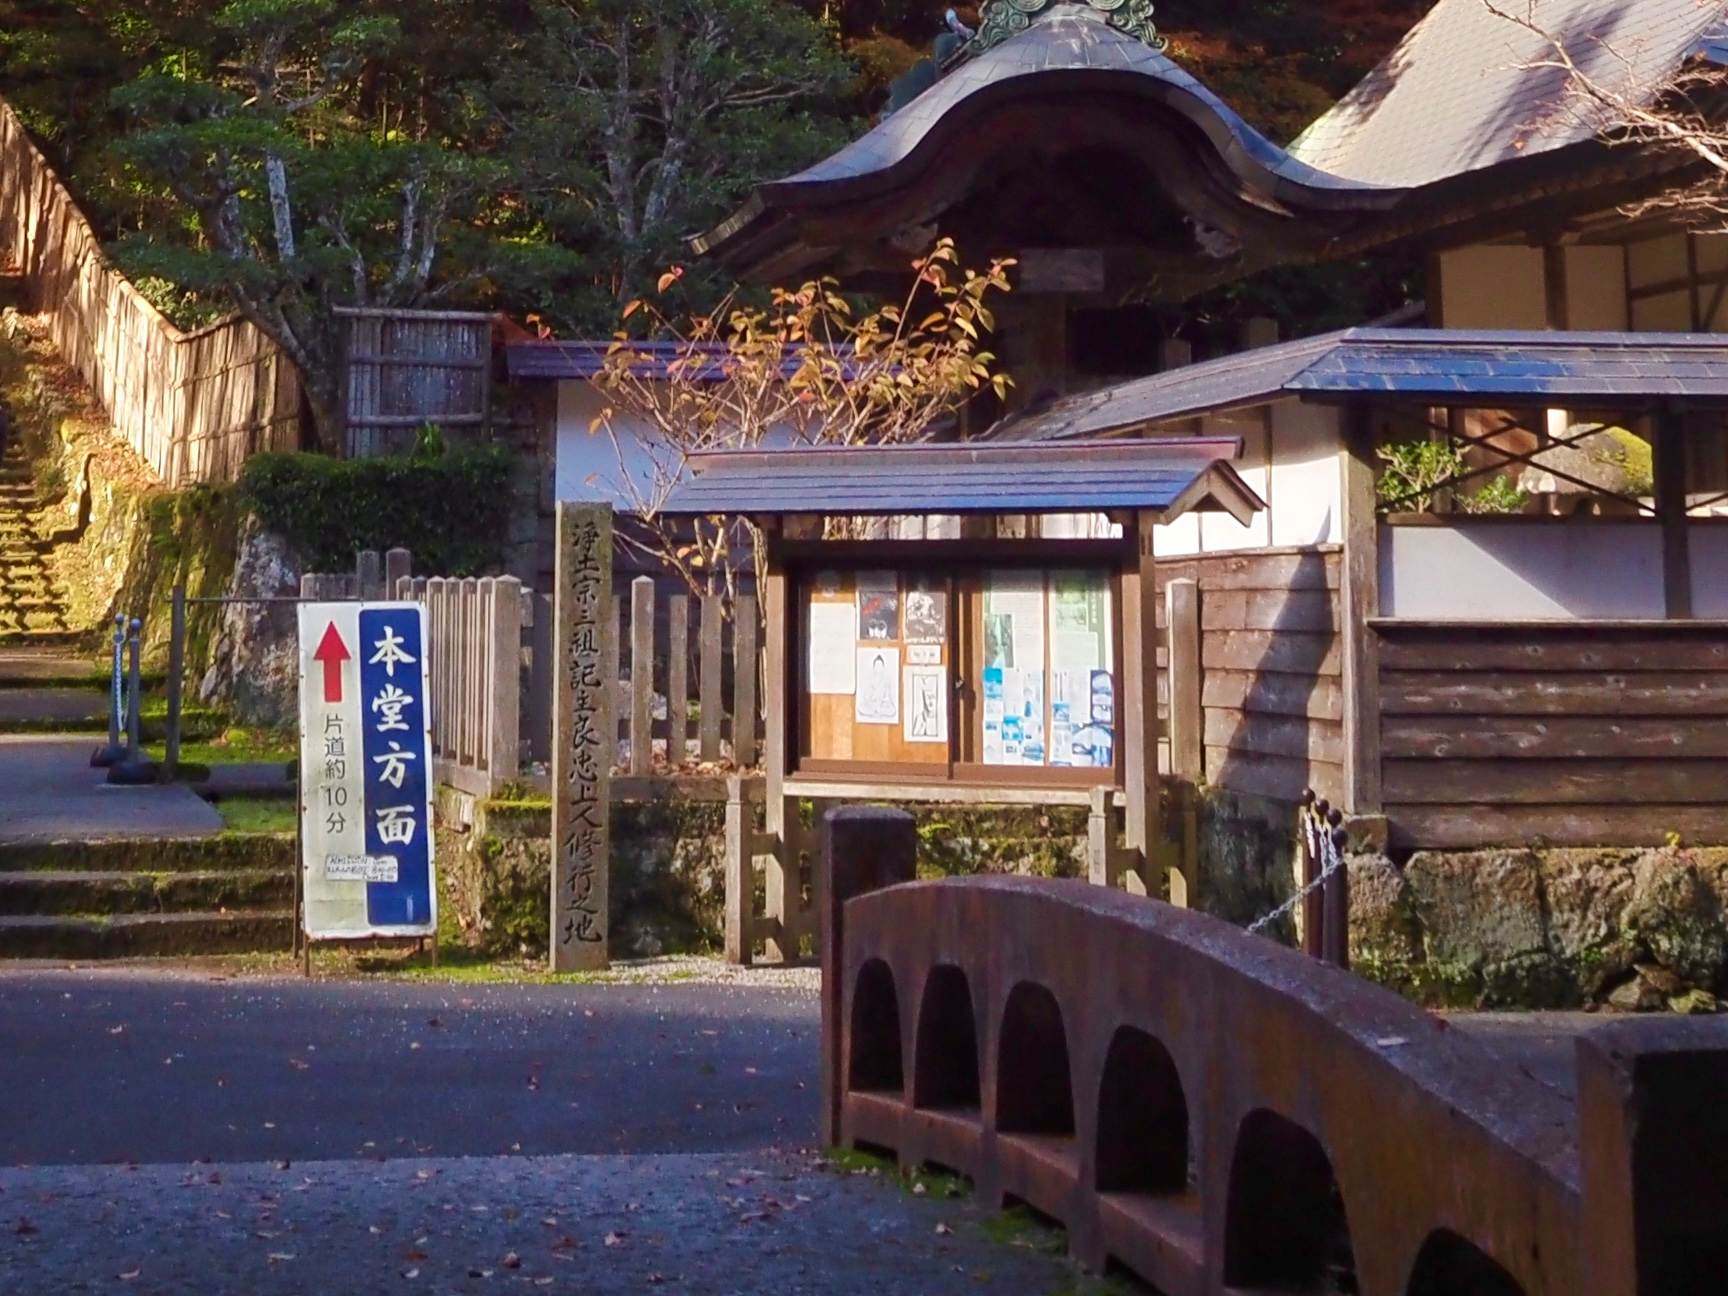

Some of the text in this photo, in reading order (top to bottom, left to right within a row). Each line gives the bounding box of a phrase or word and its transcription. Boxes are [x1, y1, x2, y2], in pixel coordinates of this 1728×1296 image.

[323, 714, 348, 834] 片道約10分
[368, 625, 417, 846] 本堂方面
